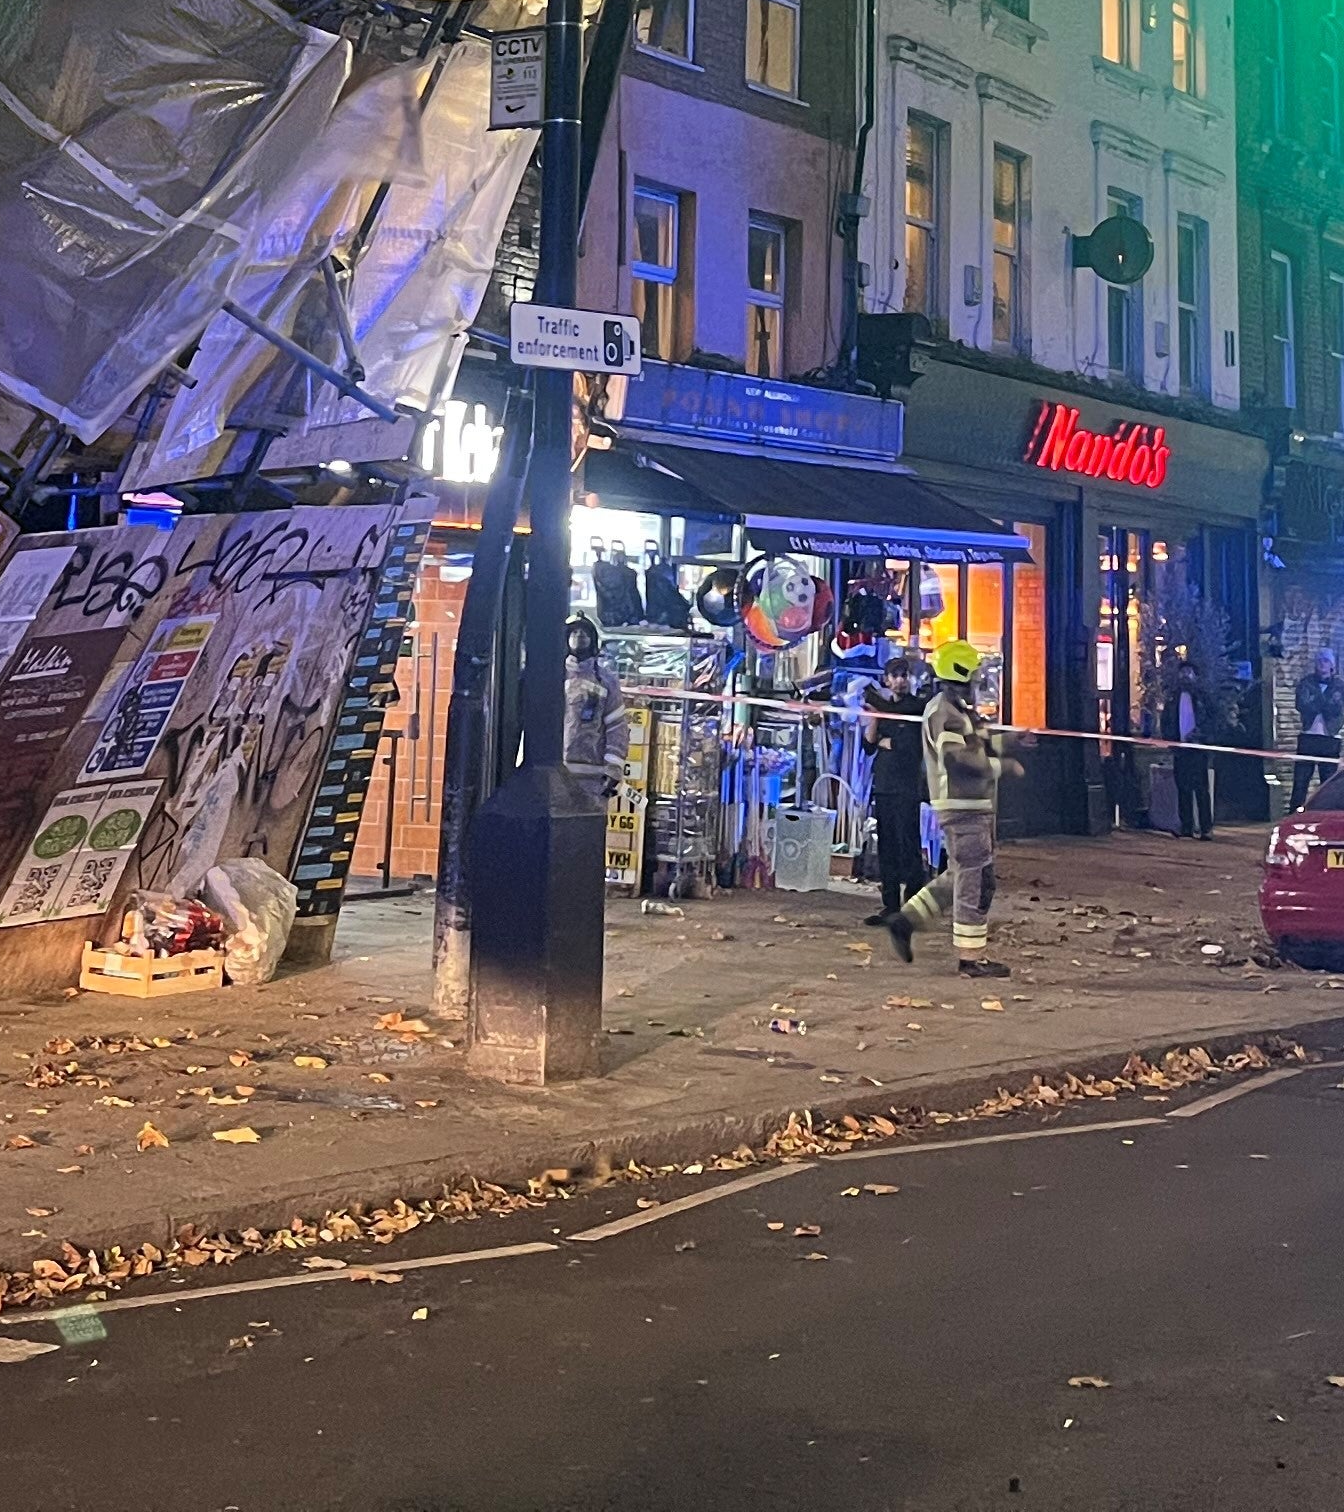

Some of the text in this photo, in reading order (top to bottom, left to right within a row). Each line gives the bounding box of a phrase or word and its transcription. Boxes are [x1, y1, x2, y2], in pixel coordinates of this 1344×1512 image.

[495, 36, 542, 56] CCTV
[537, 316, 579, 337] Traffic
[518, 338, 599, 361] enforcement
[1036, 404, 1171, 488] Nando's
